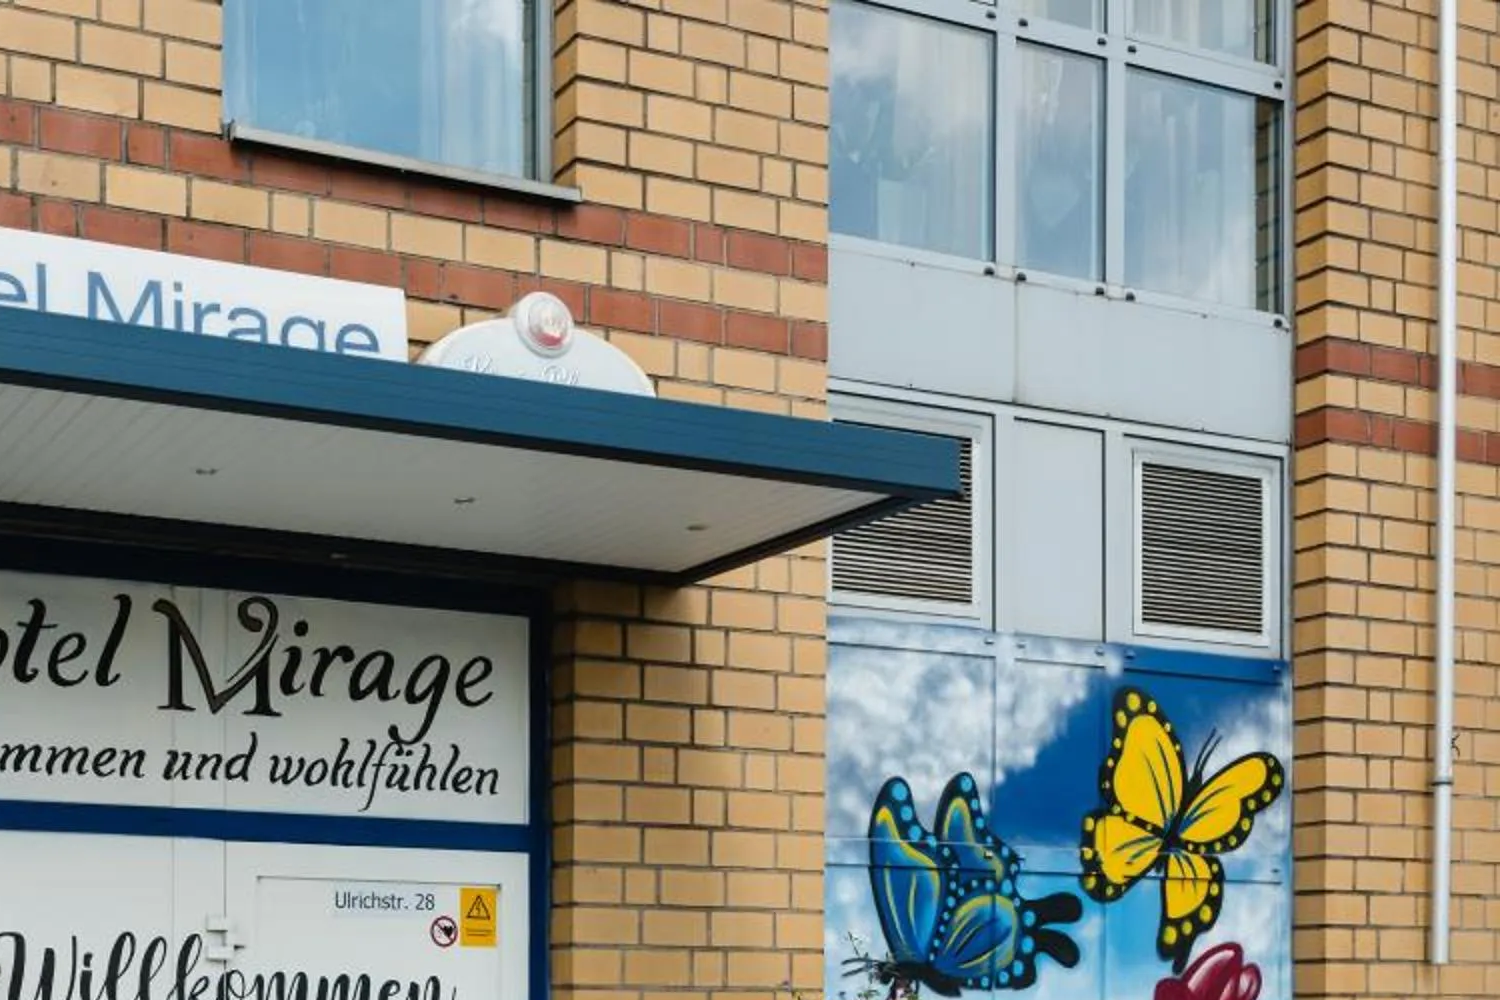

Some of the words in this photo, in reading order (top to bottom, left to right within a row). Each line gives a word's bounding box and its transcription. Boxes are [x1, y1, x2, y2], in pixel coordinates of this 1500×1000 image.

[87, 270, 381, 355] Mirage
[152, 595, 494, 745] Mirage
[162, 732, 258, 782] und
[269, 738, 500, 812] wohlfühlen
[335, 890, 409, 910] Ulrichstr.
[415, 892, 436, 911] 28
